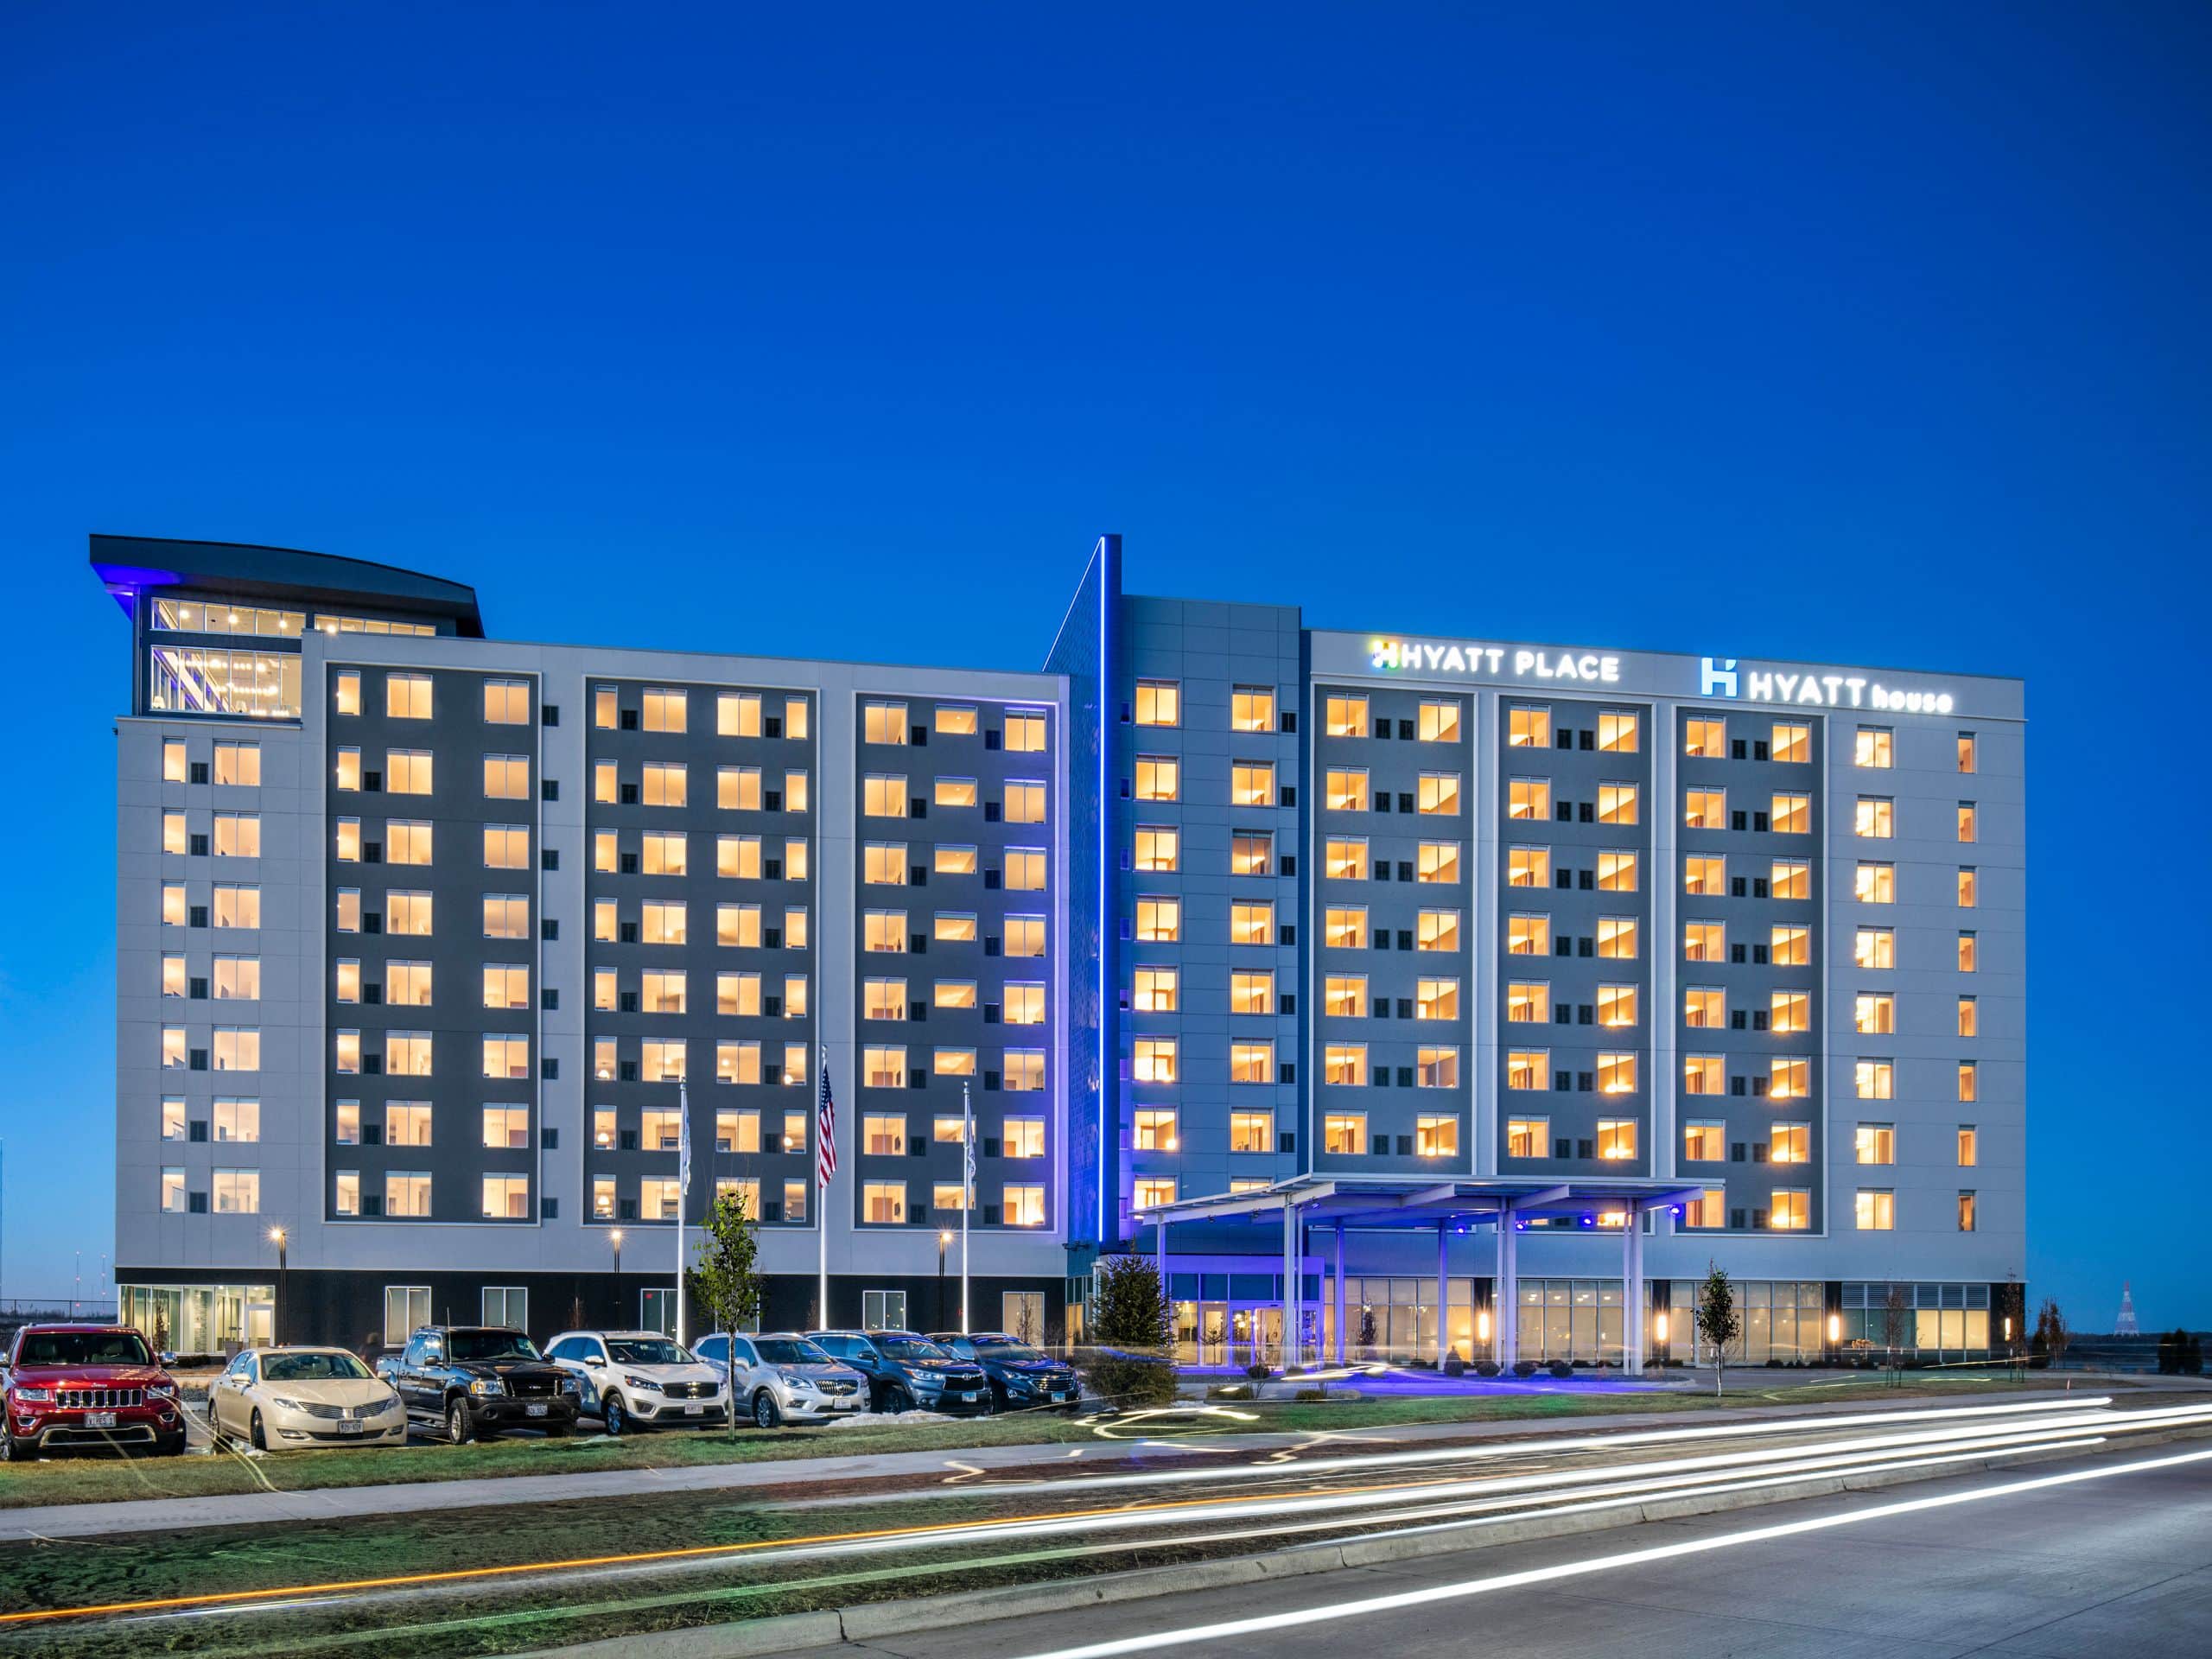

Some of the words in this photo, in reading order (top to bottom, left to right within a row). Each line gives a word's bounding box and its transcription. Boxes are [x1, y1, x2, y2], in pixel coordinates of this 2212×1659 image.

[1401, 644, 1504, 674] HYATT
[1515, 651, 1620, 682] PLACE
[1749, 671, 1867, 707] HYATT
[1872, 684, 1954, 714] house
